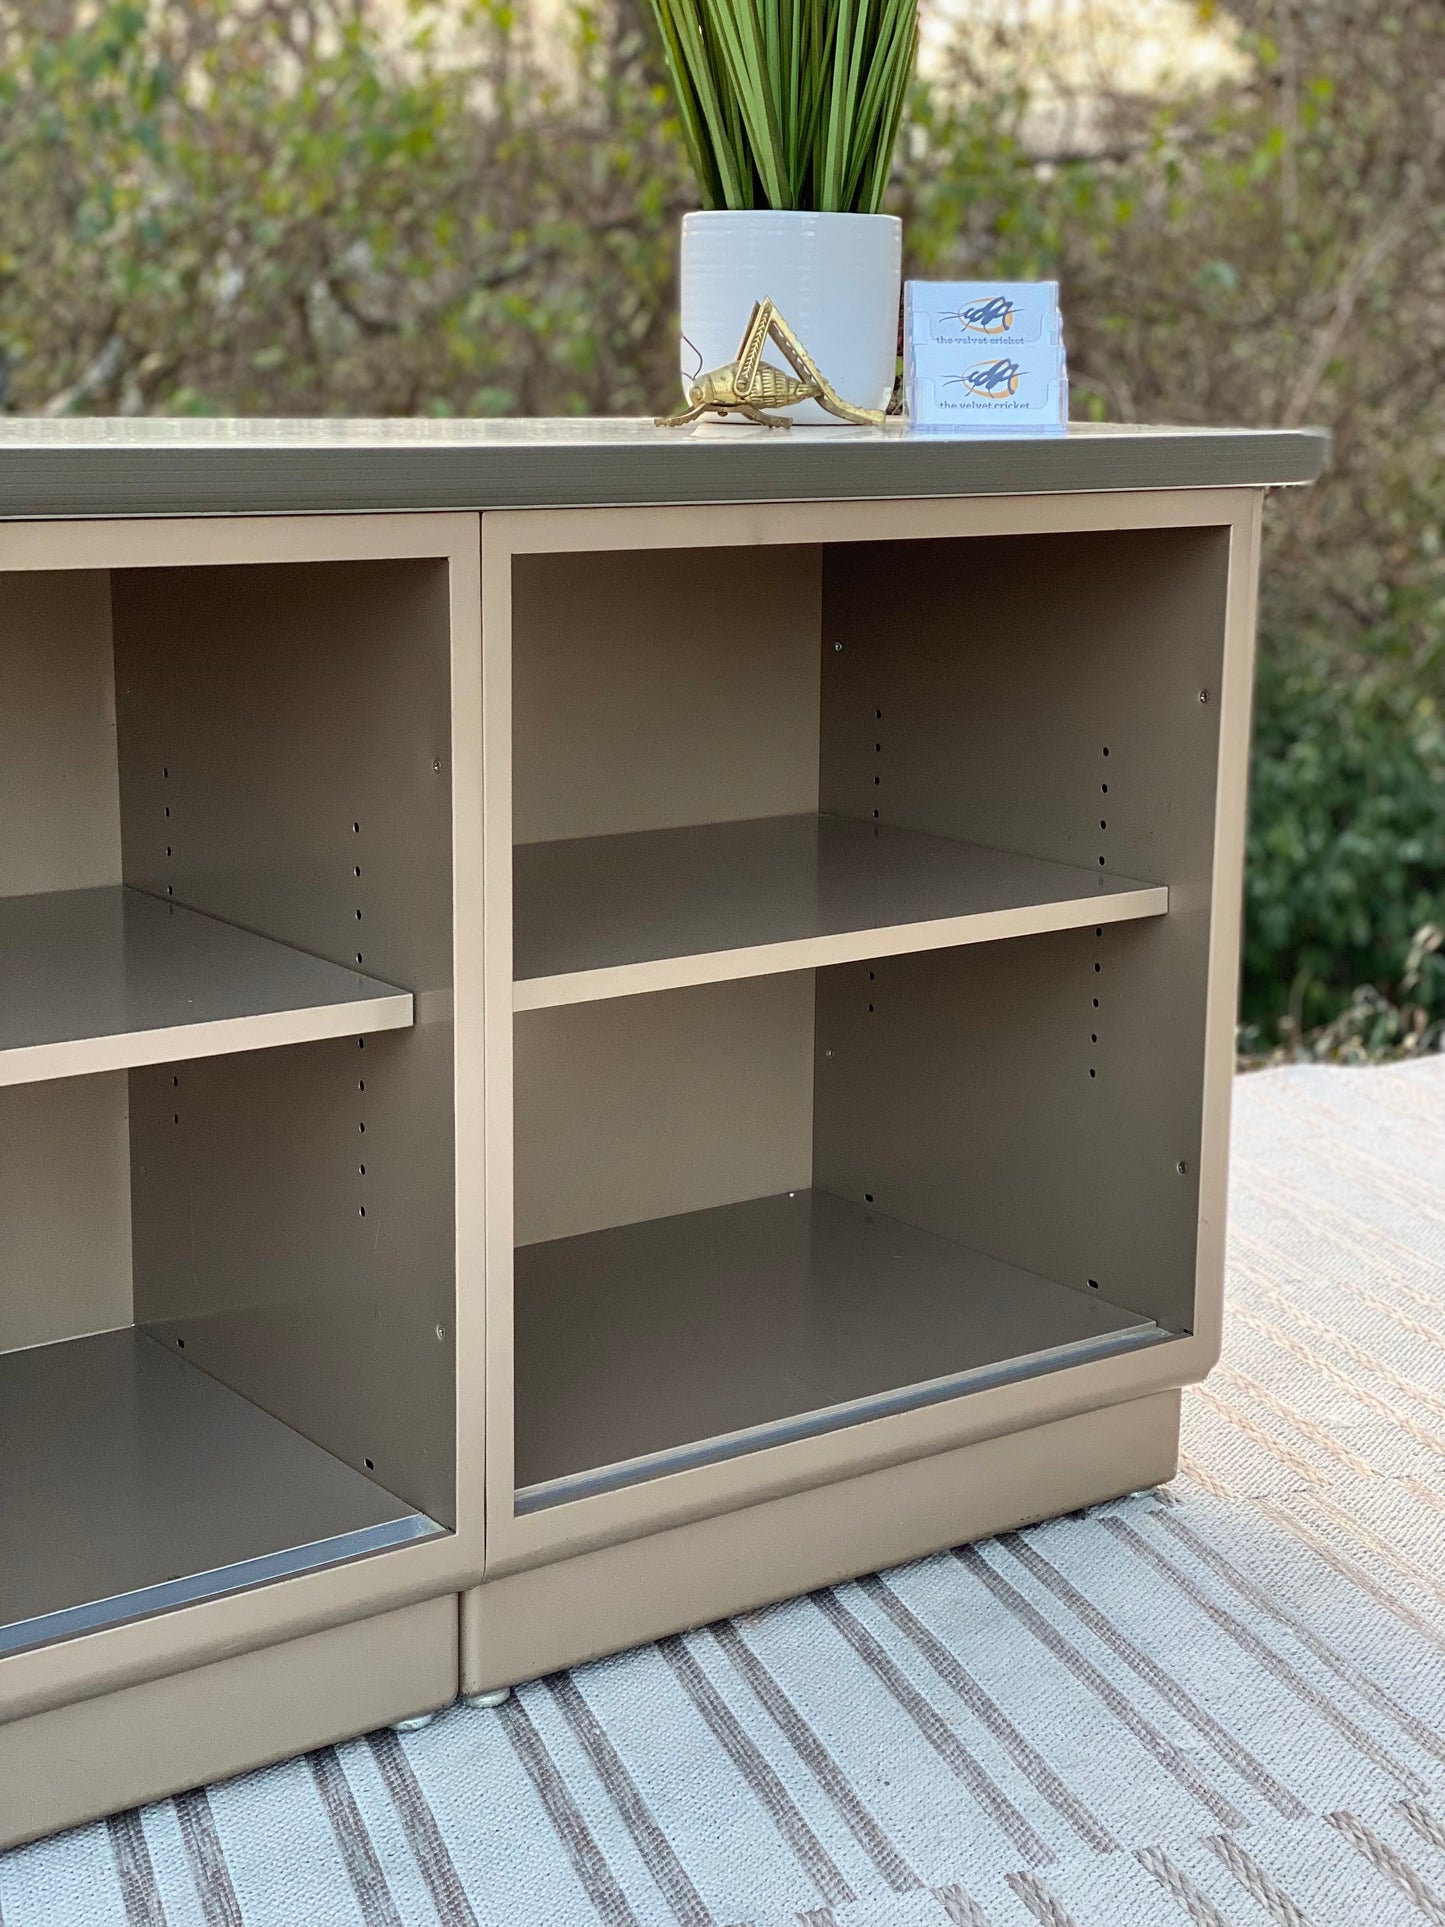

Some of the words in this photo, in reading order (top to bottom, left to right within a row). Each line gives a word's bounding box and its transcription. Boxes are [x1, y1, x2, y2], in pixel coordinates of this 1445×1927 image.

[936, 336, 953, 344] the
[955, 336, 988, 345] velvet
[990, 336, 1025, 345] cricket
[940, 401, 957, 409] the
[959, 401, 992, 409] velvet
[994, 401, 1030, 409] cricket
